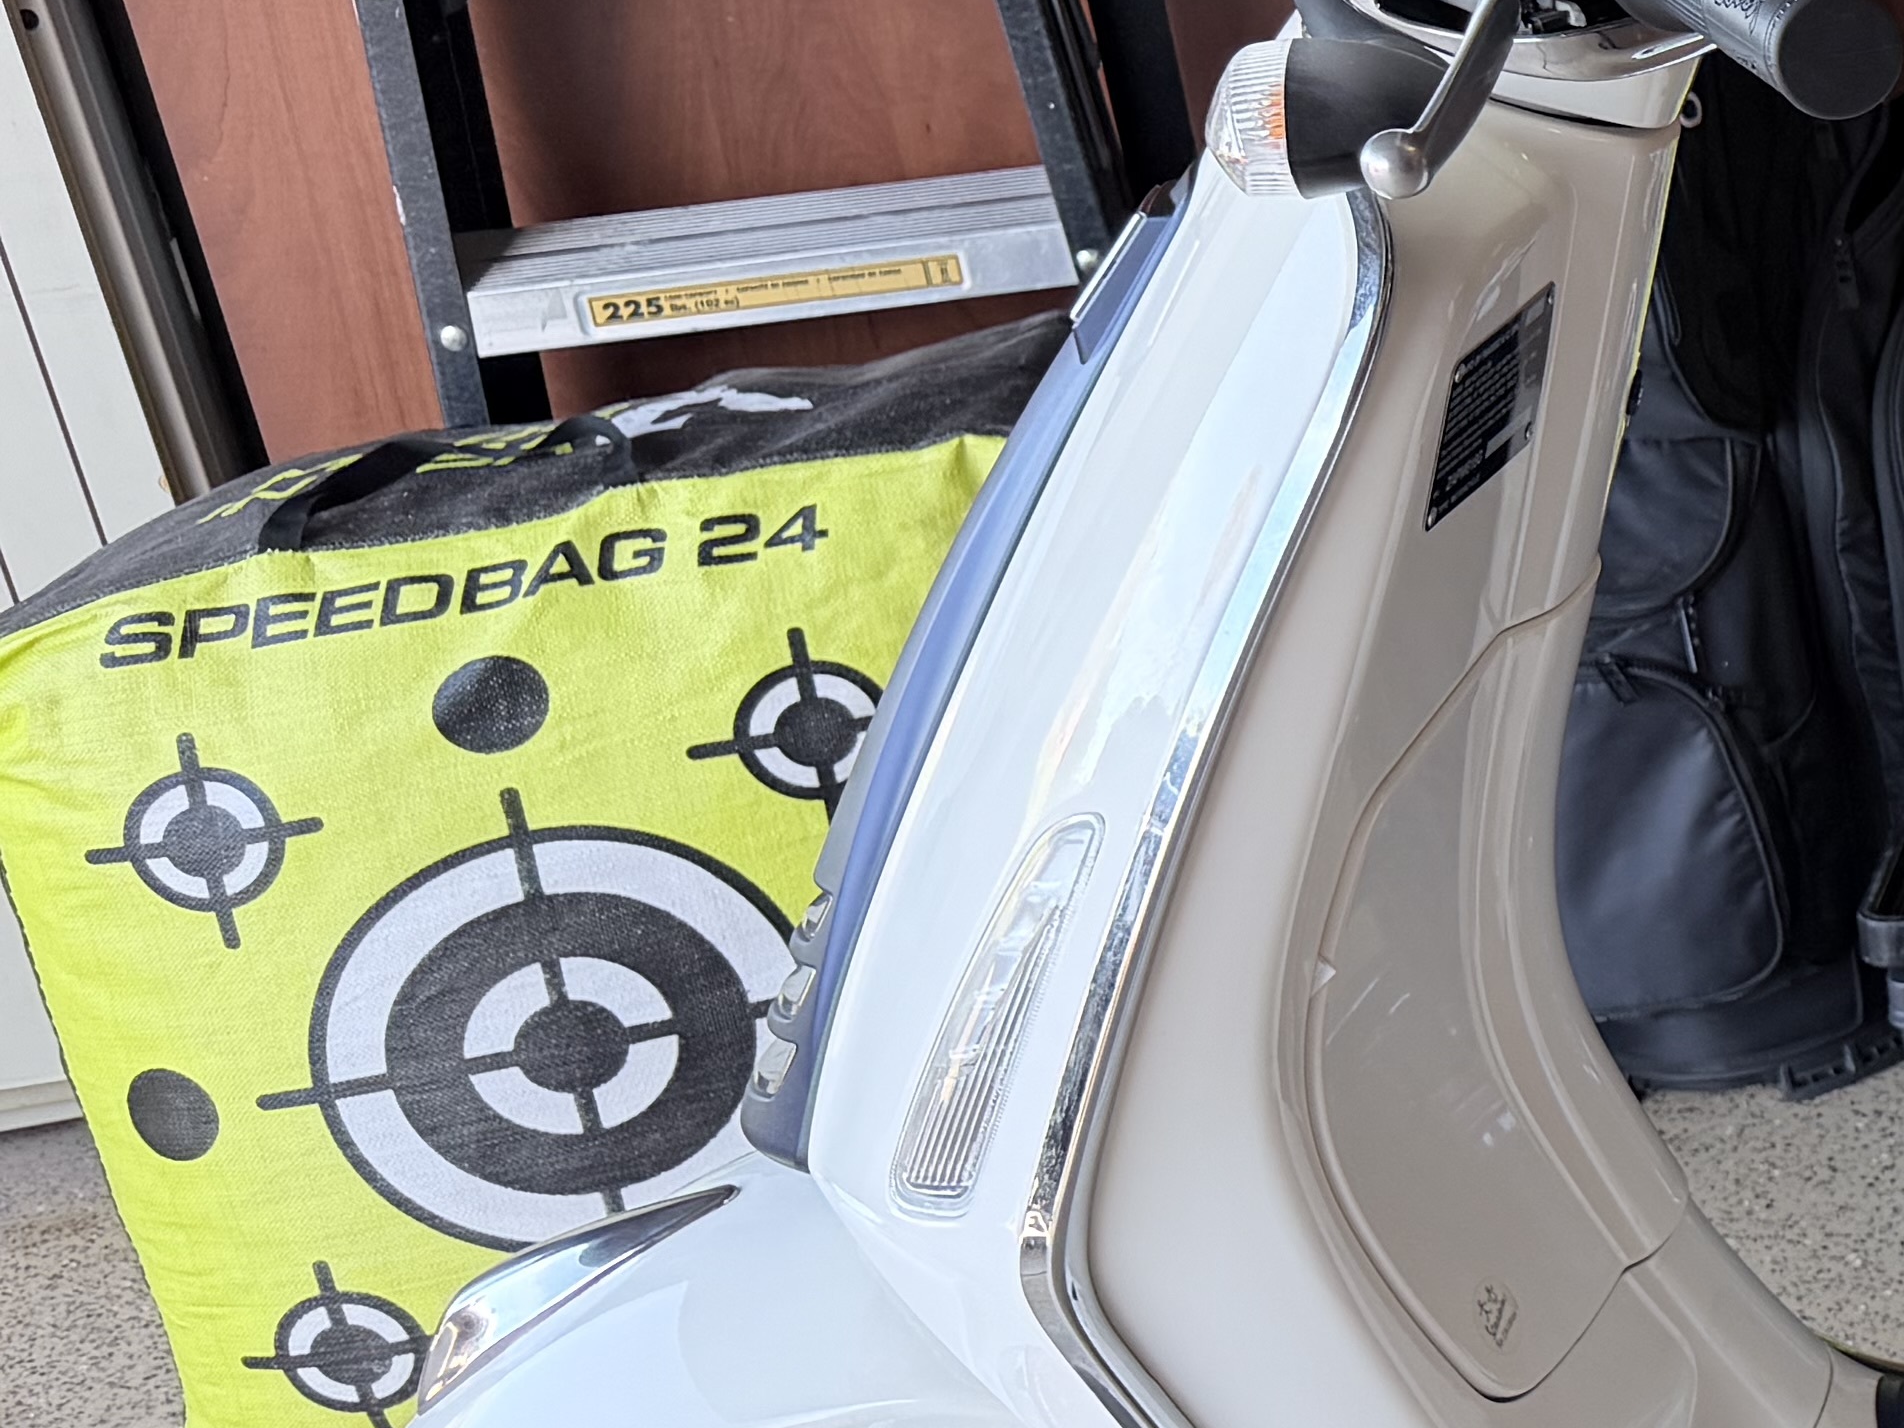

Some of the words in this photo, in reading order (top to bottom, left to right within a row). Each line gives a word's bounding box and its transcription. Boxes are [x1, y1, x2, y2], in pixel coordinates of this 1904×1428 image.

[602, 296, 665, 322] 225
[99, 527, 668, 670] SPEEDBAG
[696, 503, 829, 569] 24
